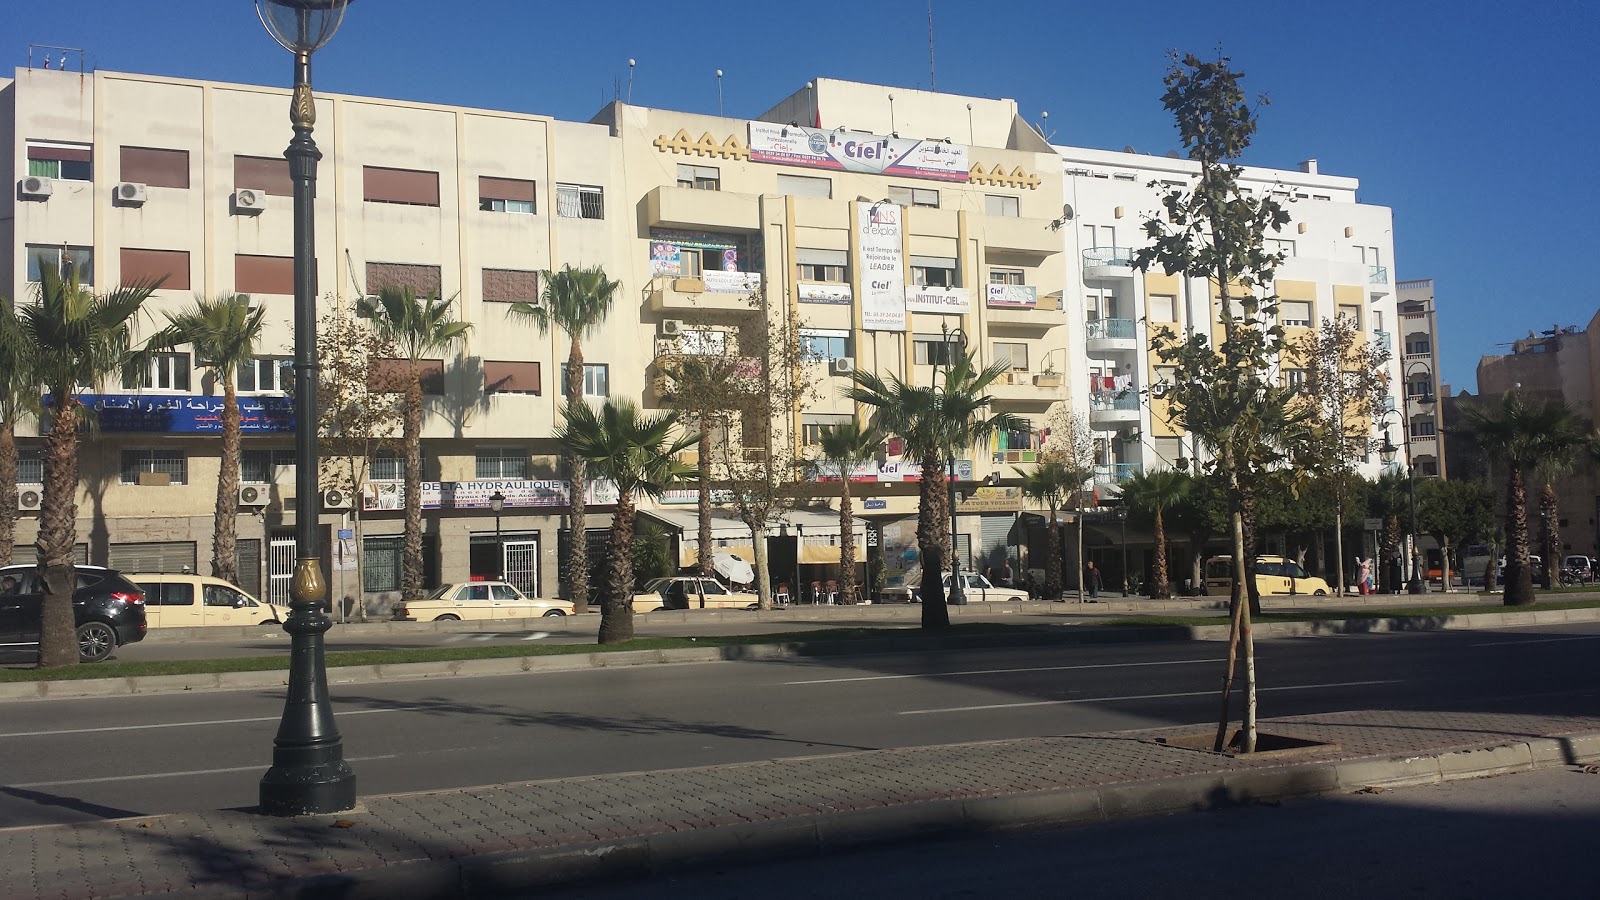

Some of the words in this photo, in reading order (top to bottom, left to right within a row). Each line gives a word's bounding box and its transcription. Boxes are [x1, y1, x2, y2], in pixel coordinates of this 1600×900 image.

[844, 141, 882, 160] Ciel
[866, 253, 891, 261] Rejoindre
[869, 263, 895, 271] LEADER
[871, 280, 890, 290] Ciel
[990, 287, 1003, 295] Ciel
[422, 482, 463, 490] DELTA
[468, 481, 559, 490] HYDRAULIQUE
